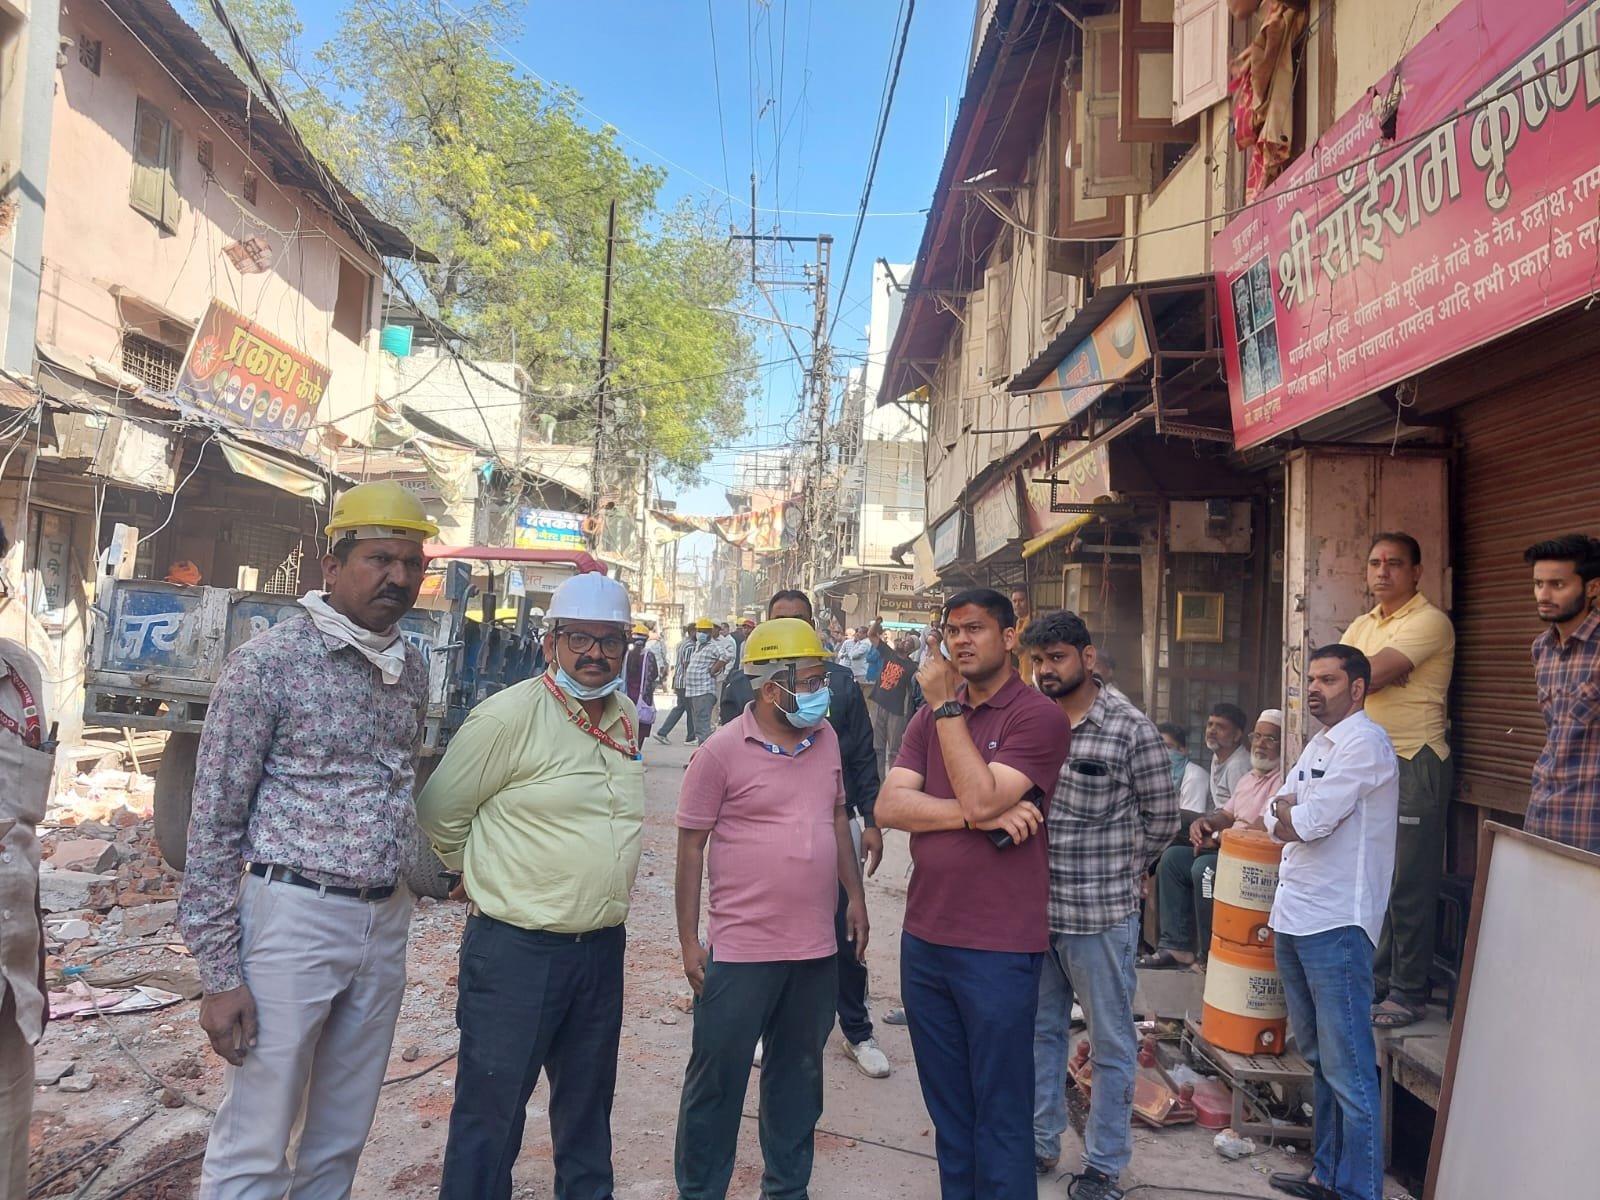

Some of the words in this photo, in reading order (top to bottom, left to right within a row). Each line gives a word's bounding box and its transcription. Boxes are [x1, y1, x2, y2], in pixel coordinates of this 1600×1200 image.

[1278, 210, 1314, 309] श्री
[1336, 347, 1357, 374] शिव
[1437, 281, 1470, 320] आदि
[1472, 262, 1504, 304] सभी
[1508, 243, 1550, 287] प्रकार
[1553, 227, 1573, 260] के
[1354, 297, 1383, 327] पीतल
[1385, 282, 1400, 311] की
[1473, 229, 1489, 257] के
[223, 326, 301, 393] प्रकाश
[880, 599, 912, 610] Goyal
